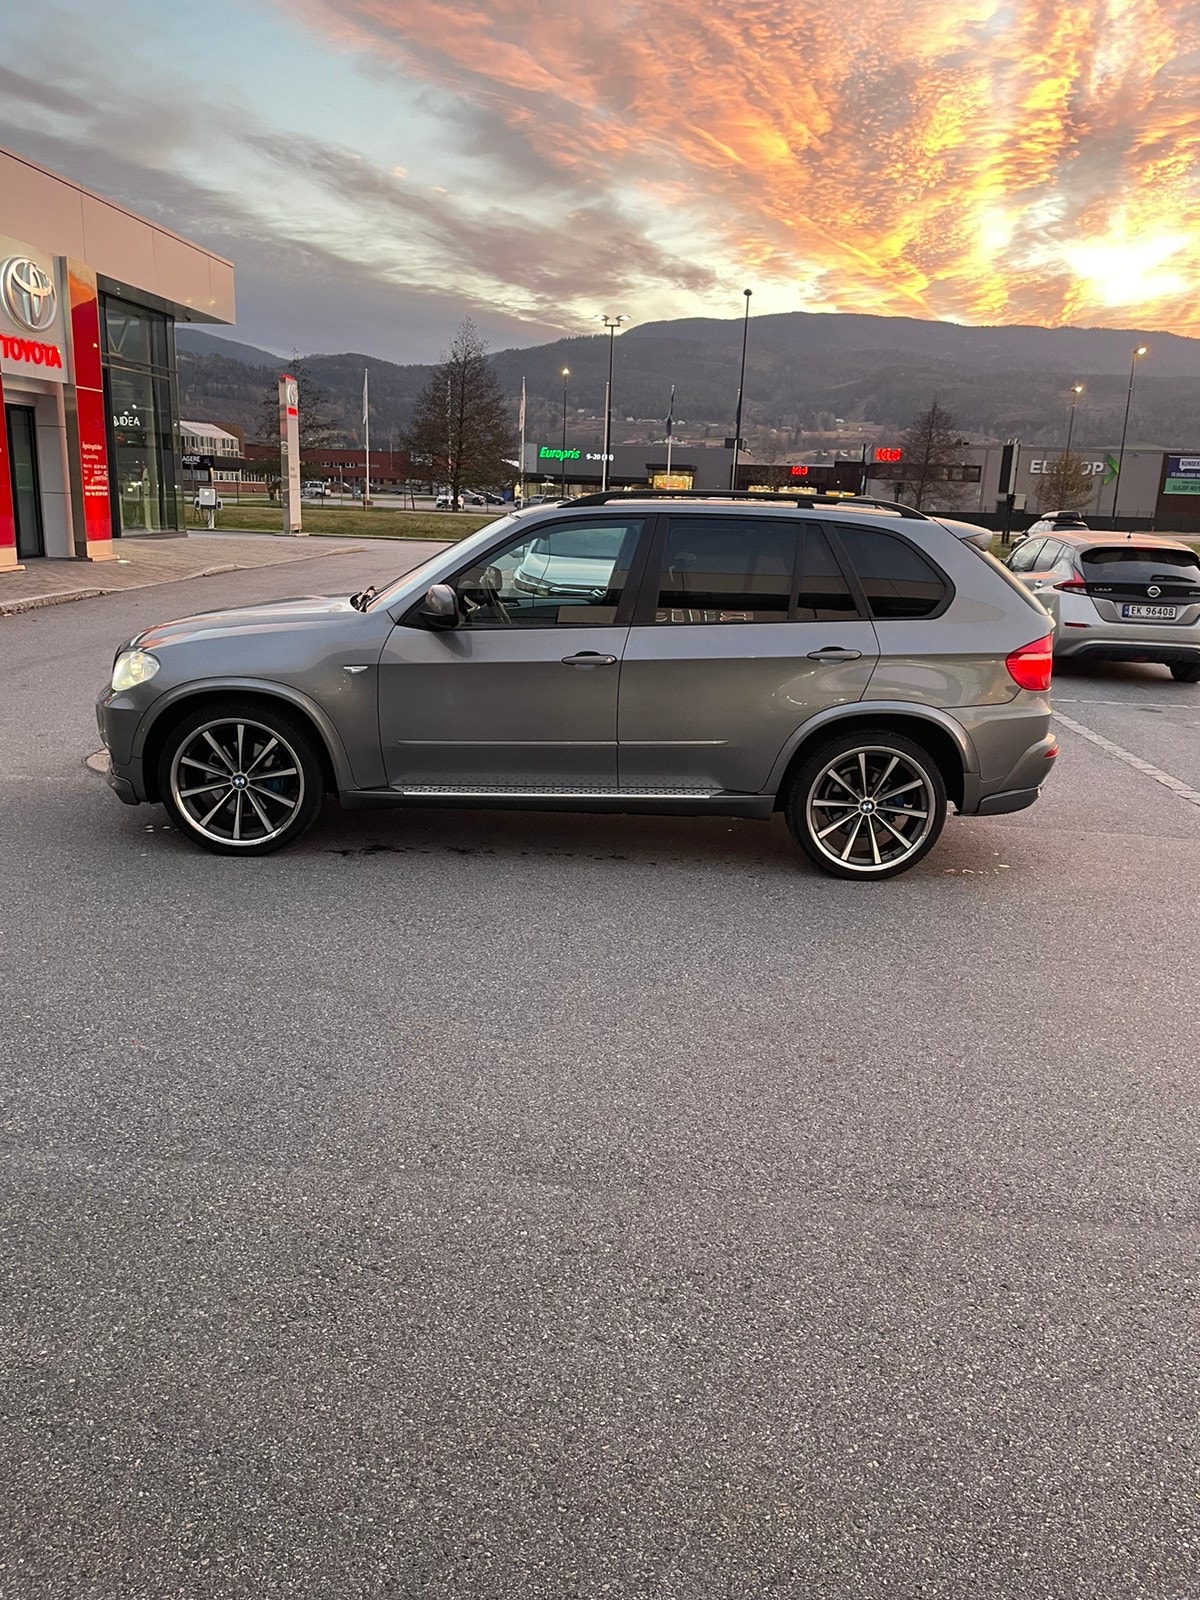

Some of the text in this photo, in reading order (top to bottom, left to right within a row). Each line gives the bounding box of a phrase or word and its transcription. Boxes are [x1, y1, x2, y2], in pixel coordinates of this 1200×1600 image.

[0, 334, 62, 369] TOYOTA
[539, 446, 581, 462] Europris
[875, 447, 902, 462] Kid
[791, 465, 809, 476] Kid
[1131, 607, 1174, 617] EK 96408
